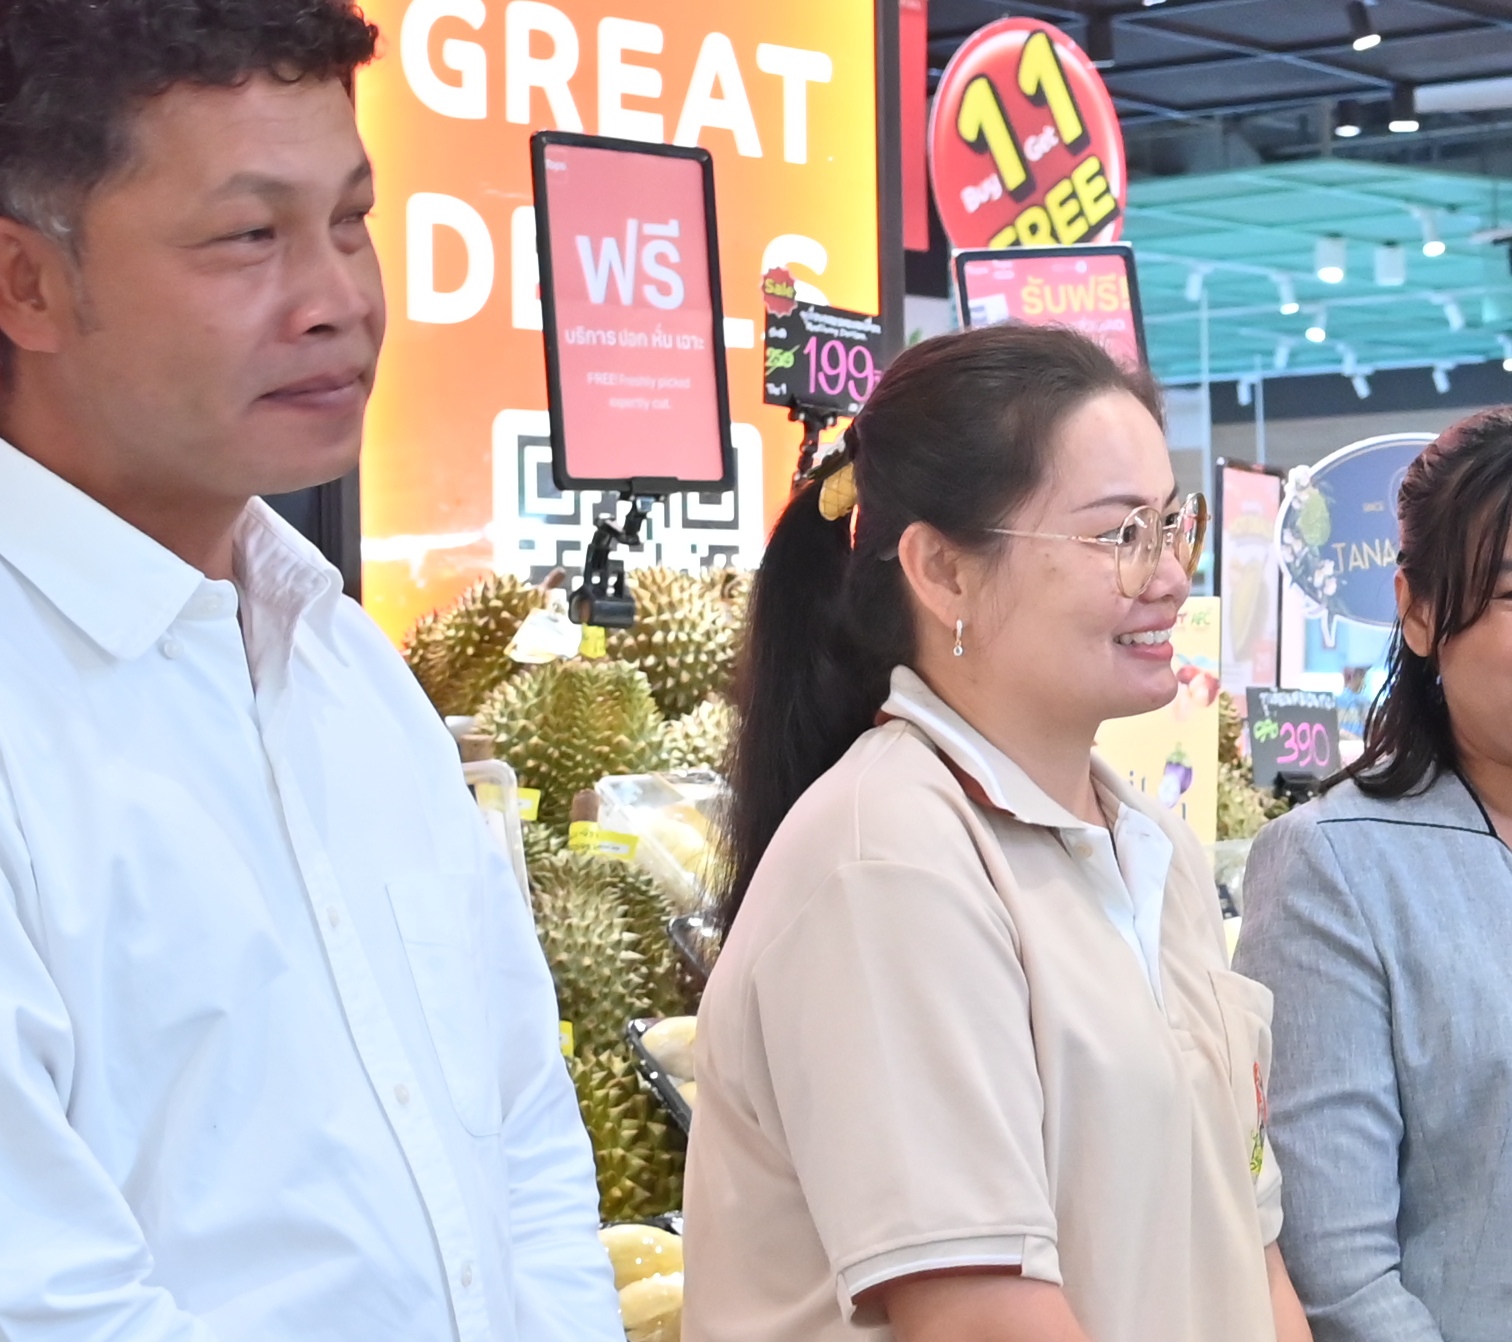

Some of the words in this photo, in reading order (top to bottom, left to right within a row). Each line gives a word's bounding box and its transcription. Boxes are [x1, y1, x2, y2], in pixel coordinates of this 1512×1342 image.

[575, 218, 685, 310] ฟรี
[764, 278, 795, 299] Sale
[803, 336, 874, 402] 199
[1277, 722, 1330, 767] 390
